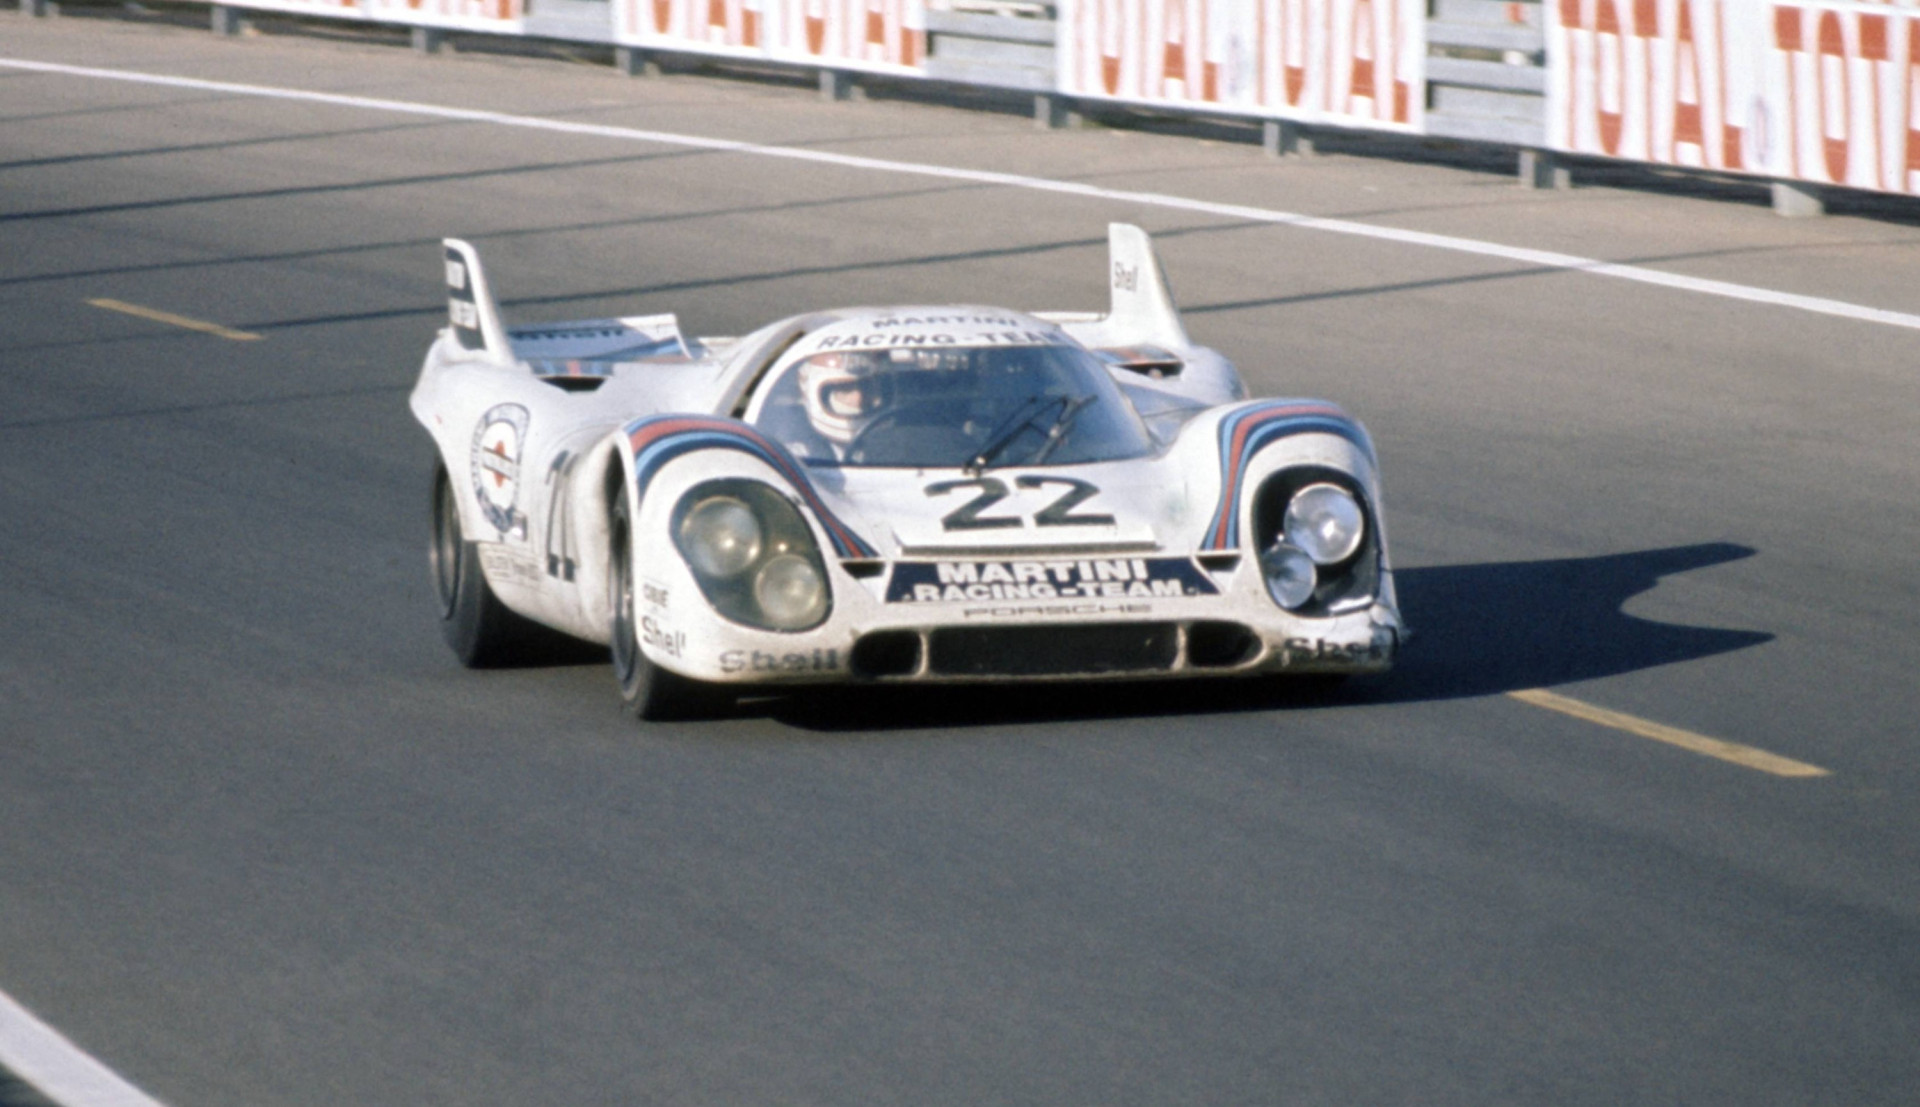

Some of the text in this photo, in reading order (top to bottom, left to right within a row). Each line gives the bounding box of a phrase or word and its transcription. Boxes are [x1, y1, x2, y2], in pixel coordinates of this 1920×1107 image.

[923, 475, 1117, 532] 22
[936, 558, 1149, 584] MARTINI
[913, 578, 1184, 602] RACING-TEAM
[964, 603, 1153, 618] PORSCHE
[641, 614, 687, 658] Shell
[719, 647, 839, 673] Shell
